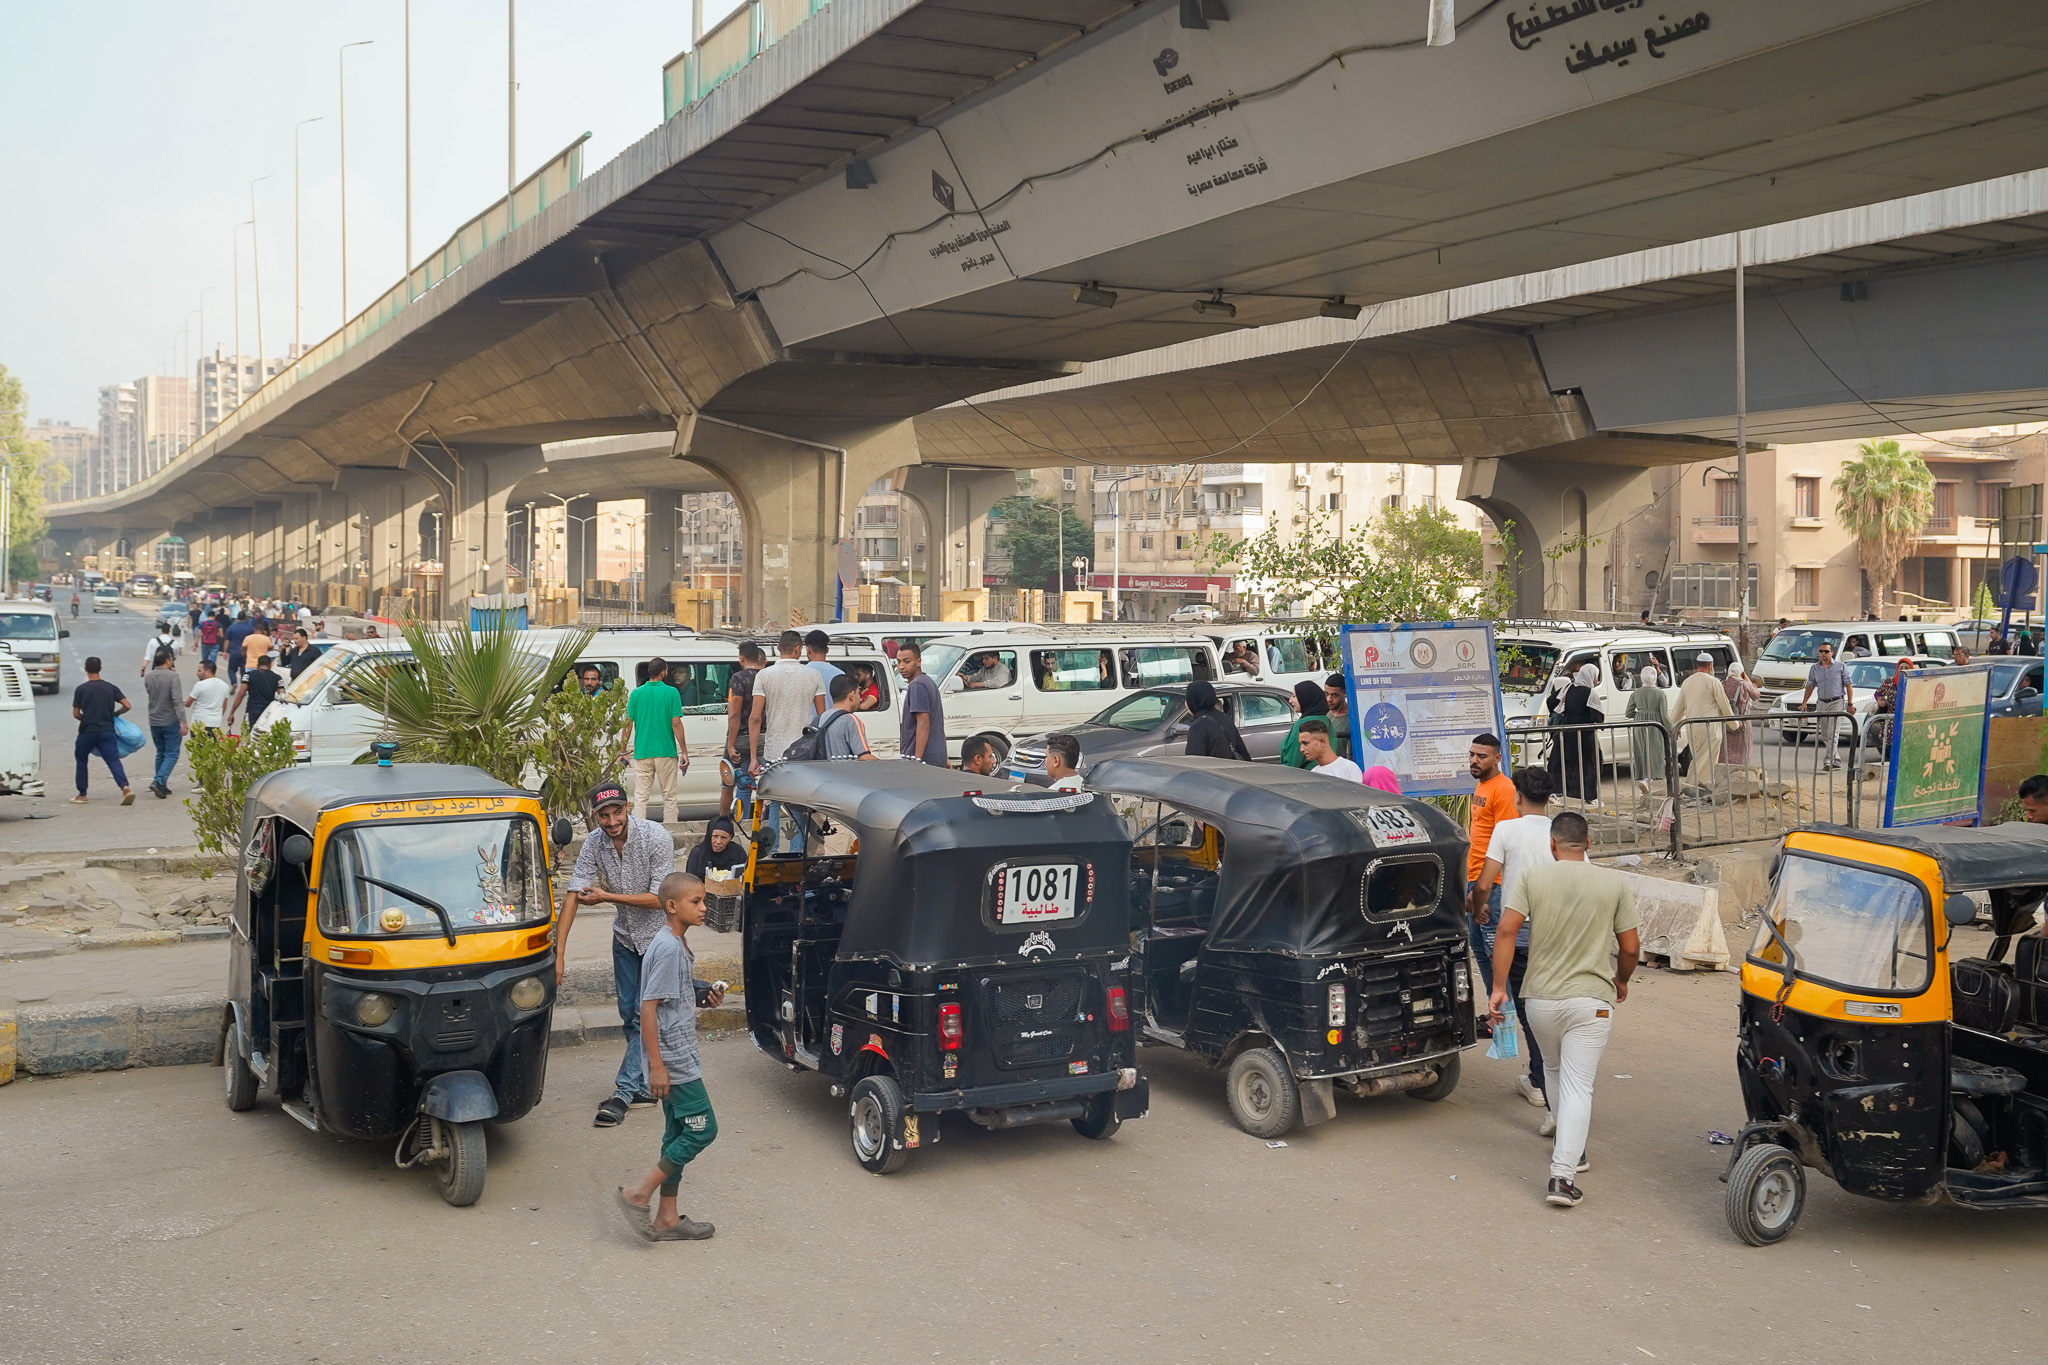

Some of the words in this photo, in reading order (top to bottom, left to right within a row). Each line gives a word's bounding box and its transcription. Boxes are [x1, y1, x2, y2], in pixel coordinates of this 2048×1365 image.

[1644, 12, 1710, 59] مصنع
[1244, 157, 1268, 176] شركة
[1186, 181, 1213, 197] مصرية
[1373, 677, 1380, 685] OF
[1914, 783, 1936, 797] تجمع
[1937, 779, 1961, 792] نقطة
[371, 801, 411, 817] الفلق
[485, 798, 504, 810] قل
[1369, 808, 1415, 830] 1483
[1012, 868, 1072, 902] 1081
[1021, 903, 1059, 918] طالبية
